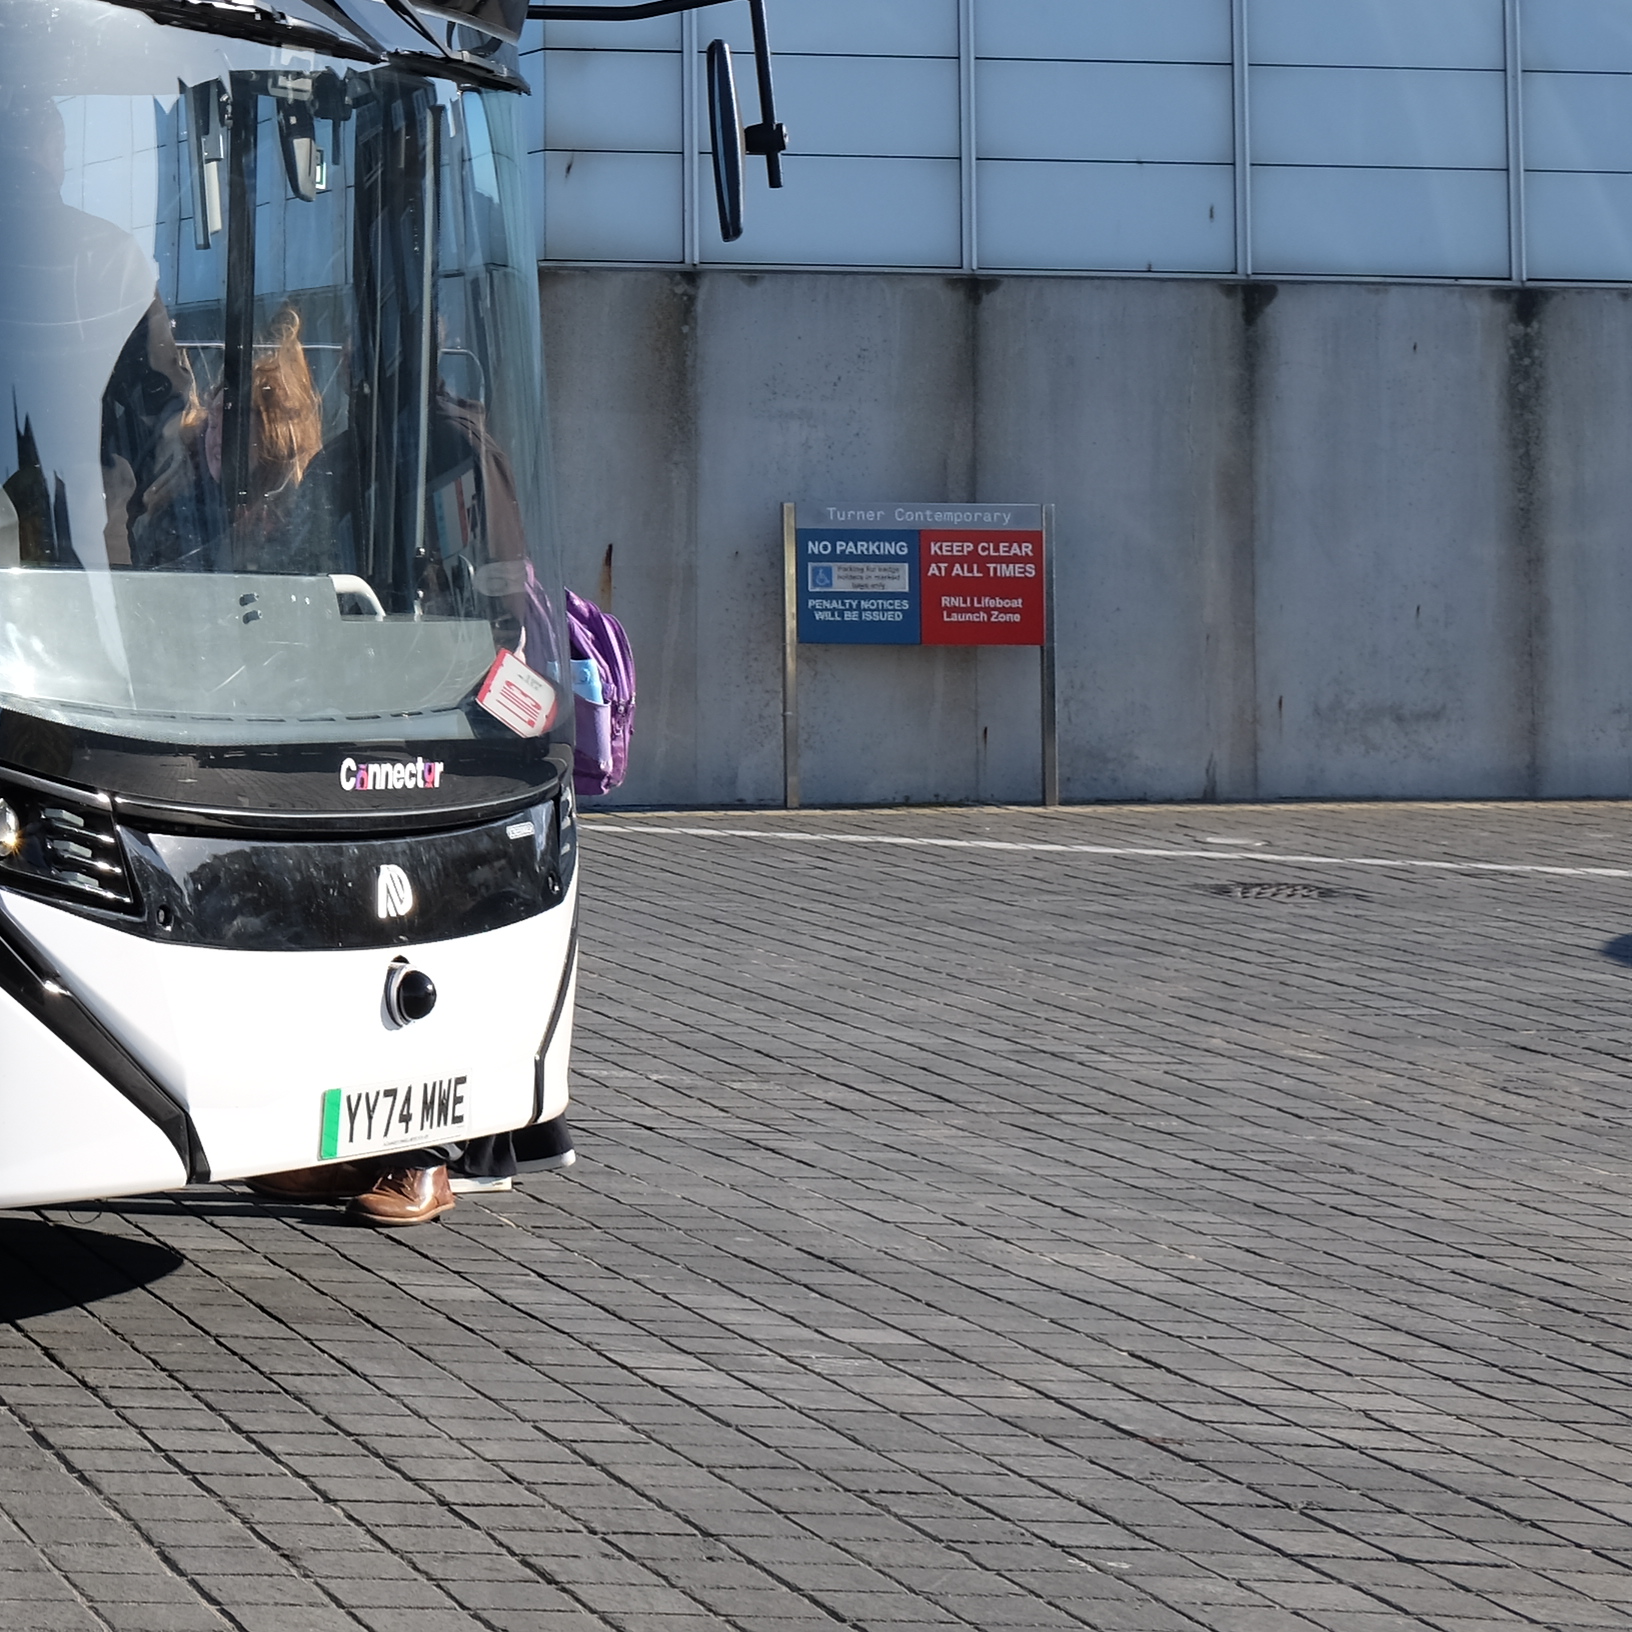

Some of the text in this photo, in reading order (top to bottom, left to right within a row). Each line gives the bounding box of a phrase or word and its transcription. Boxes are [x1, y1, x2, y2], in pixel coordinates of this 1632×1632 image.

[826, 507, 1011, 524] Turner Contemporary
[808, 541, 908, 555] NO PARKING
[930, 542, 1033, 556] KEEP CLEAR
[927, 564, 1036, 578] AT ALL TIMES
[808, 599, 909, 610] PENALTY NOTICES
[941, 596, 1022, 608] RNLI Lifeboat
[814, 611, 903, 621] WILL BE ISSUED
[943, 610, 1021, 623] Launch Zone
[340, 757, 444, 791] Connector
[346, 1075, 467, 1143] YY74 MWE
